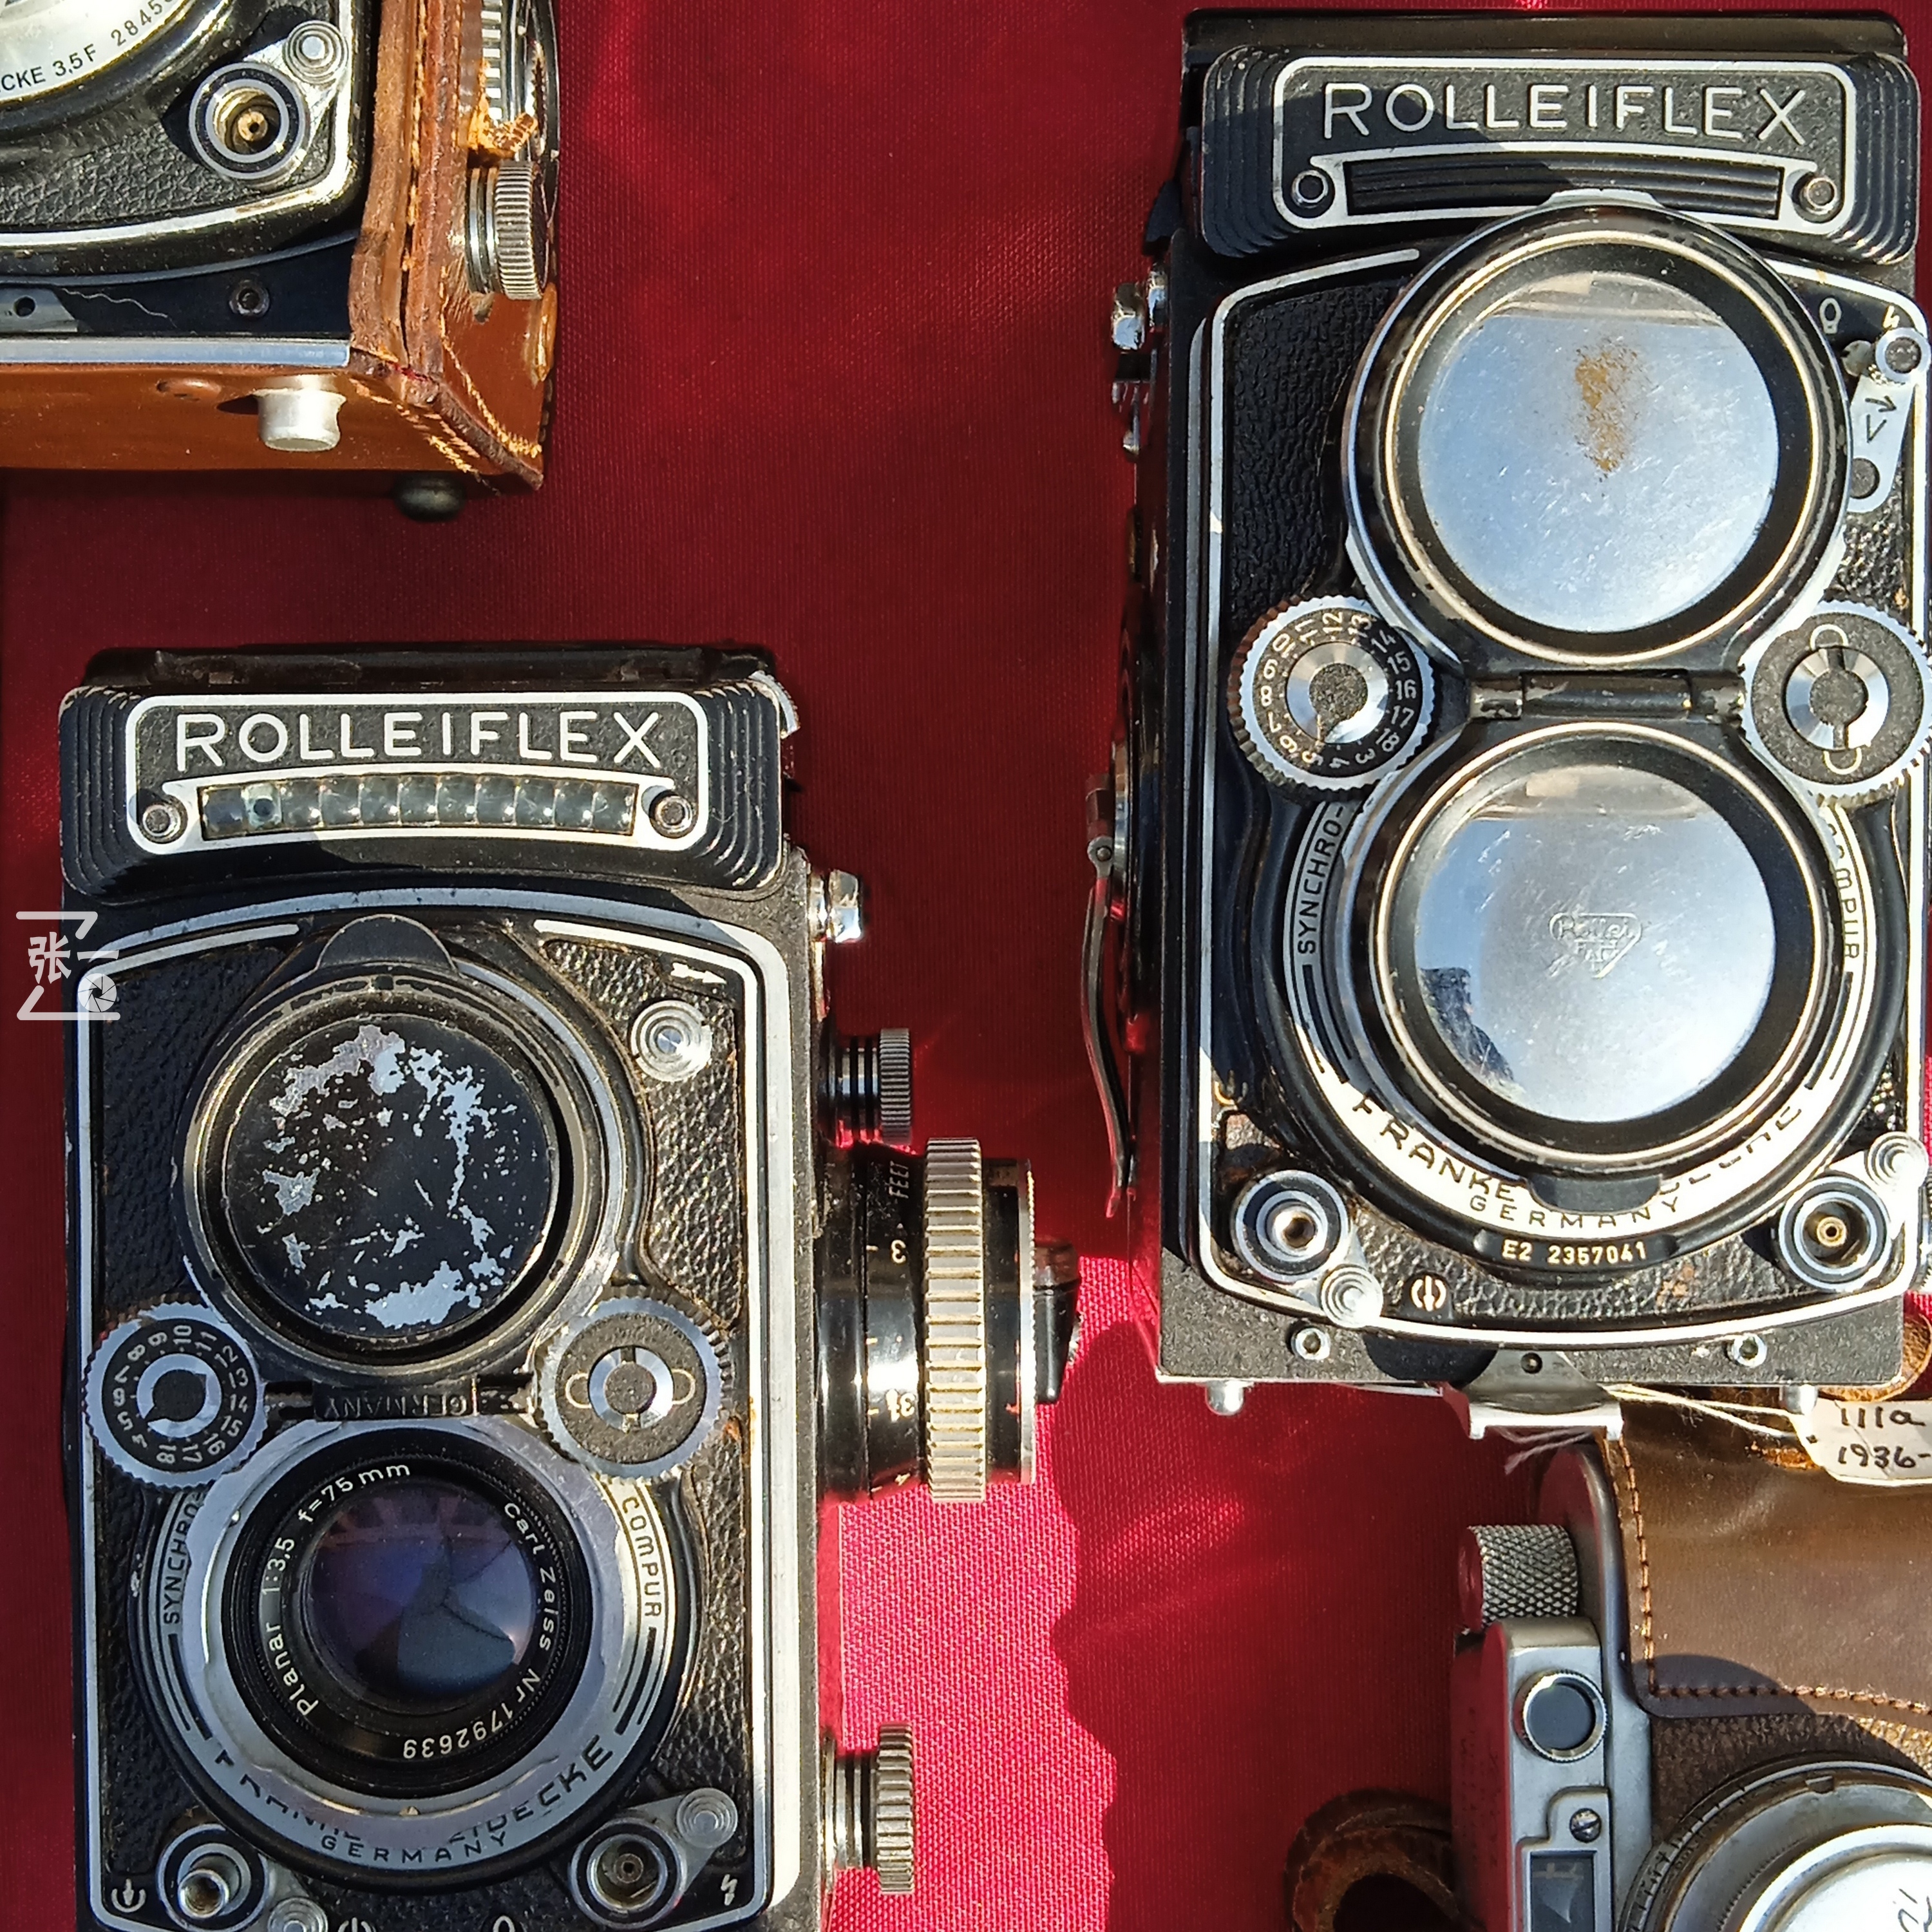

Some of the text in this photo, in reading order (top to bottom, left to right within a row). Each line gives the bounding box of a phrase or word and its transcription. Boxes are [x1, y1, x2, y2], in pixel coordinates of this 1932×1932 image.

[0, 66, 46, 92] CKE
[1323, 82, 1805, 145] ROLLEIFLEX
[1294, 619, 1318, 646] 11
[1323, 612, 1343, 633] 12
[1349, 615, 1372, 638] 13
[1273, 633, 1296, 658] 10
[1371, 630, 1396, 653] 14
[1263, 659, 1278, 679] 9
[1388, 652, 1411, 674] 15
[1261, 686, 1272, 706] 8
[1396, 679, 1416, 700] 16
[1267, 712, 1282, 733] 7
[1391, 705, 1414, 728] 17
[176, 711, 661, 772] ROLLEIFLEX
[1280, 735, 1297, 753] 6
[1376, 728, 1399, 752] 18
[1302, 751, 1323, 765] 5
[1330, 757, 1350, 768] 4
[1356, 748, 1375, 764] 3
[1352, 1096, 1515, 1202] FRANKE
[889, 1160, 909, 1198] FEET
[1470, 1195, 1678, 1229] GERMANY
[891, 1240, 906, 1264] 3
[1502, 1239, 1647, 1265] E2 2357041
[148, 1332, 167, 1345] 9
[173, 1325, 191, 1344] 10
[195, 1332, 217, 1351] 11
[128, 1345, 145, 1361] 8
[214, 1346, 238, 1368] 12
[115, 1365, 129, 1383] 7
[229, 1368, 248, 1388] 13
[113, 1388, 125, 1406] 6
[230, 1394, 248, 1412] 14
[117, 1412, 133, 1430] 5
[221, 1416, 243, 1437] 15
[132, 1434, 147, 1448] 4
[203, 1434, 225, 1454] 16
[156, 1444, 176, 1463] 18
[182, 1444, 202, 1463] 17
[621, 1497, 662, 1618] COMPUR
[402, 1503, 559, 1759] Carl Zeiss Nr 1792639
[266, 1622, 319, 1716] Planar
[321, 1831, 506, 1863] GERMANY
